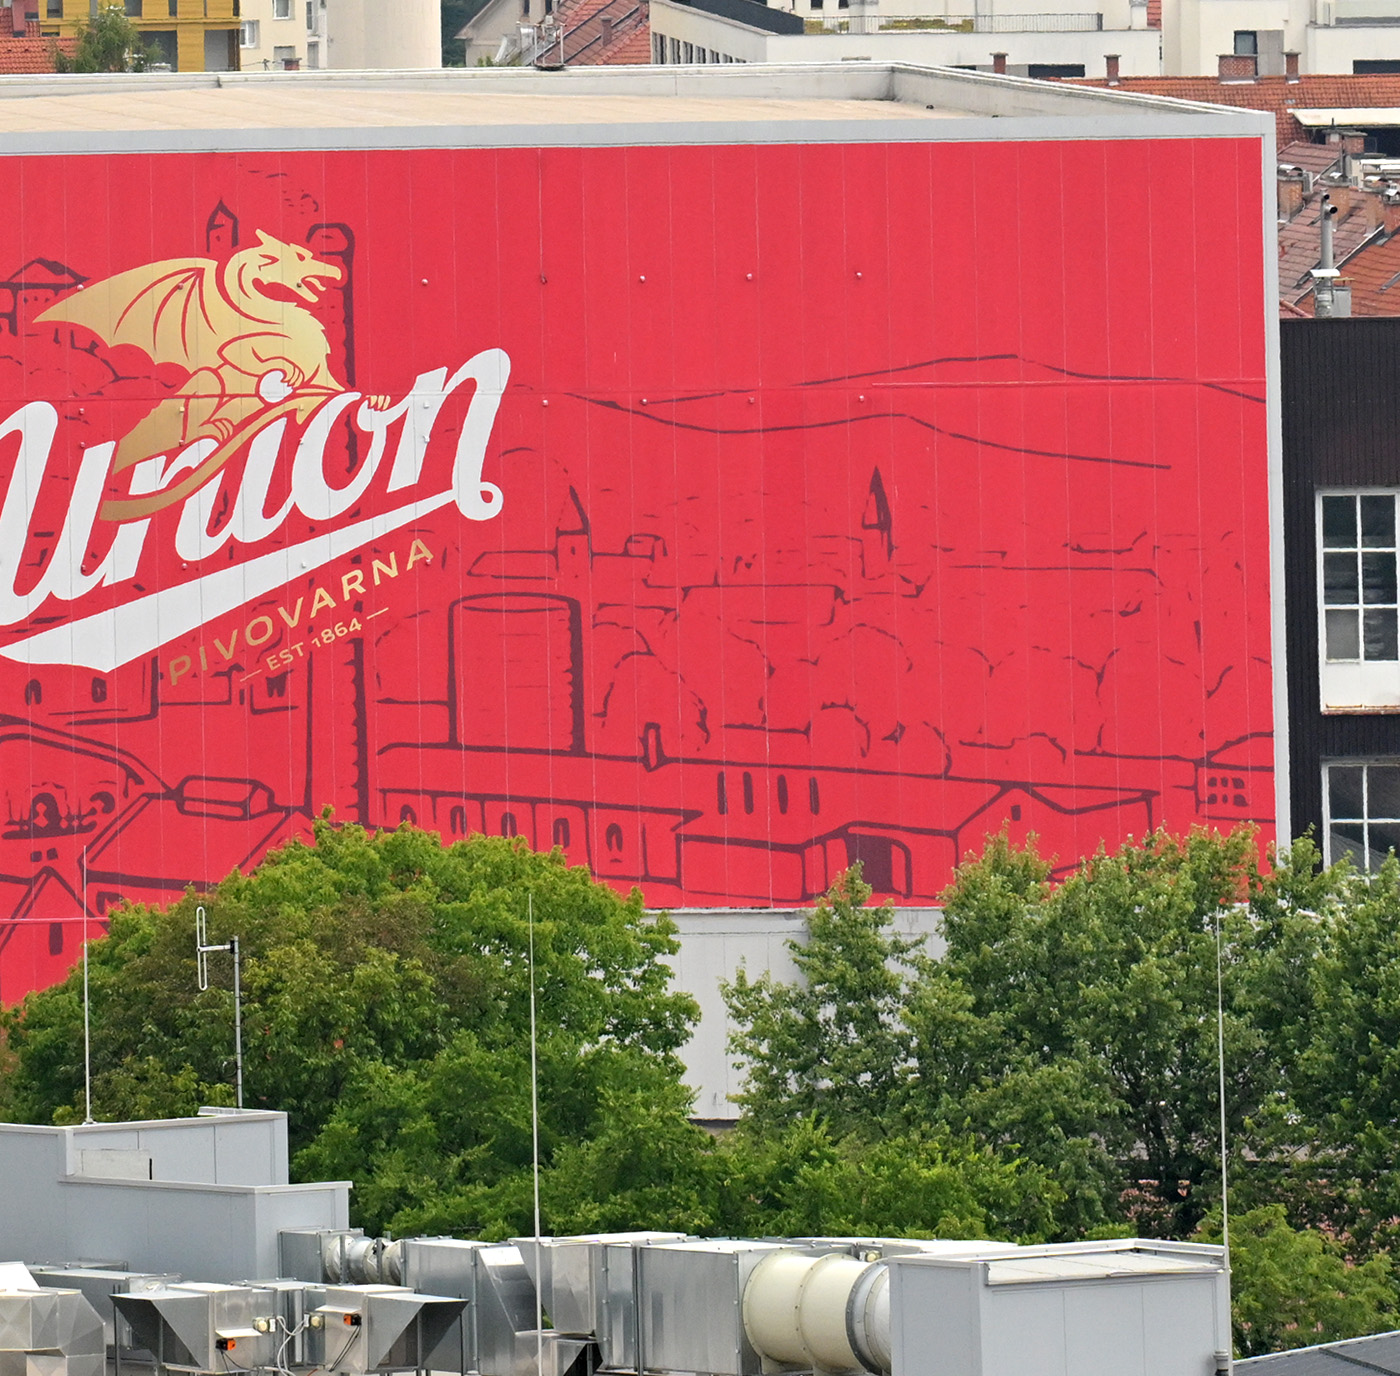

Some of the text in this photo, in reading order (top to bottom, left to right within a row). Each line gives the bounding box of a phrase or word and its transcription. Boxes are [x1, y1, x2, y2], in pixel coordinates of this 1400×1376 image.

[169, 538, 435, 686] PIVOVARNA
[266, 618, 363, 671] EST 1864
